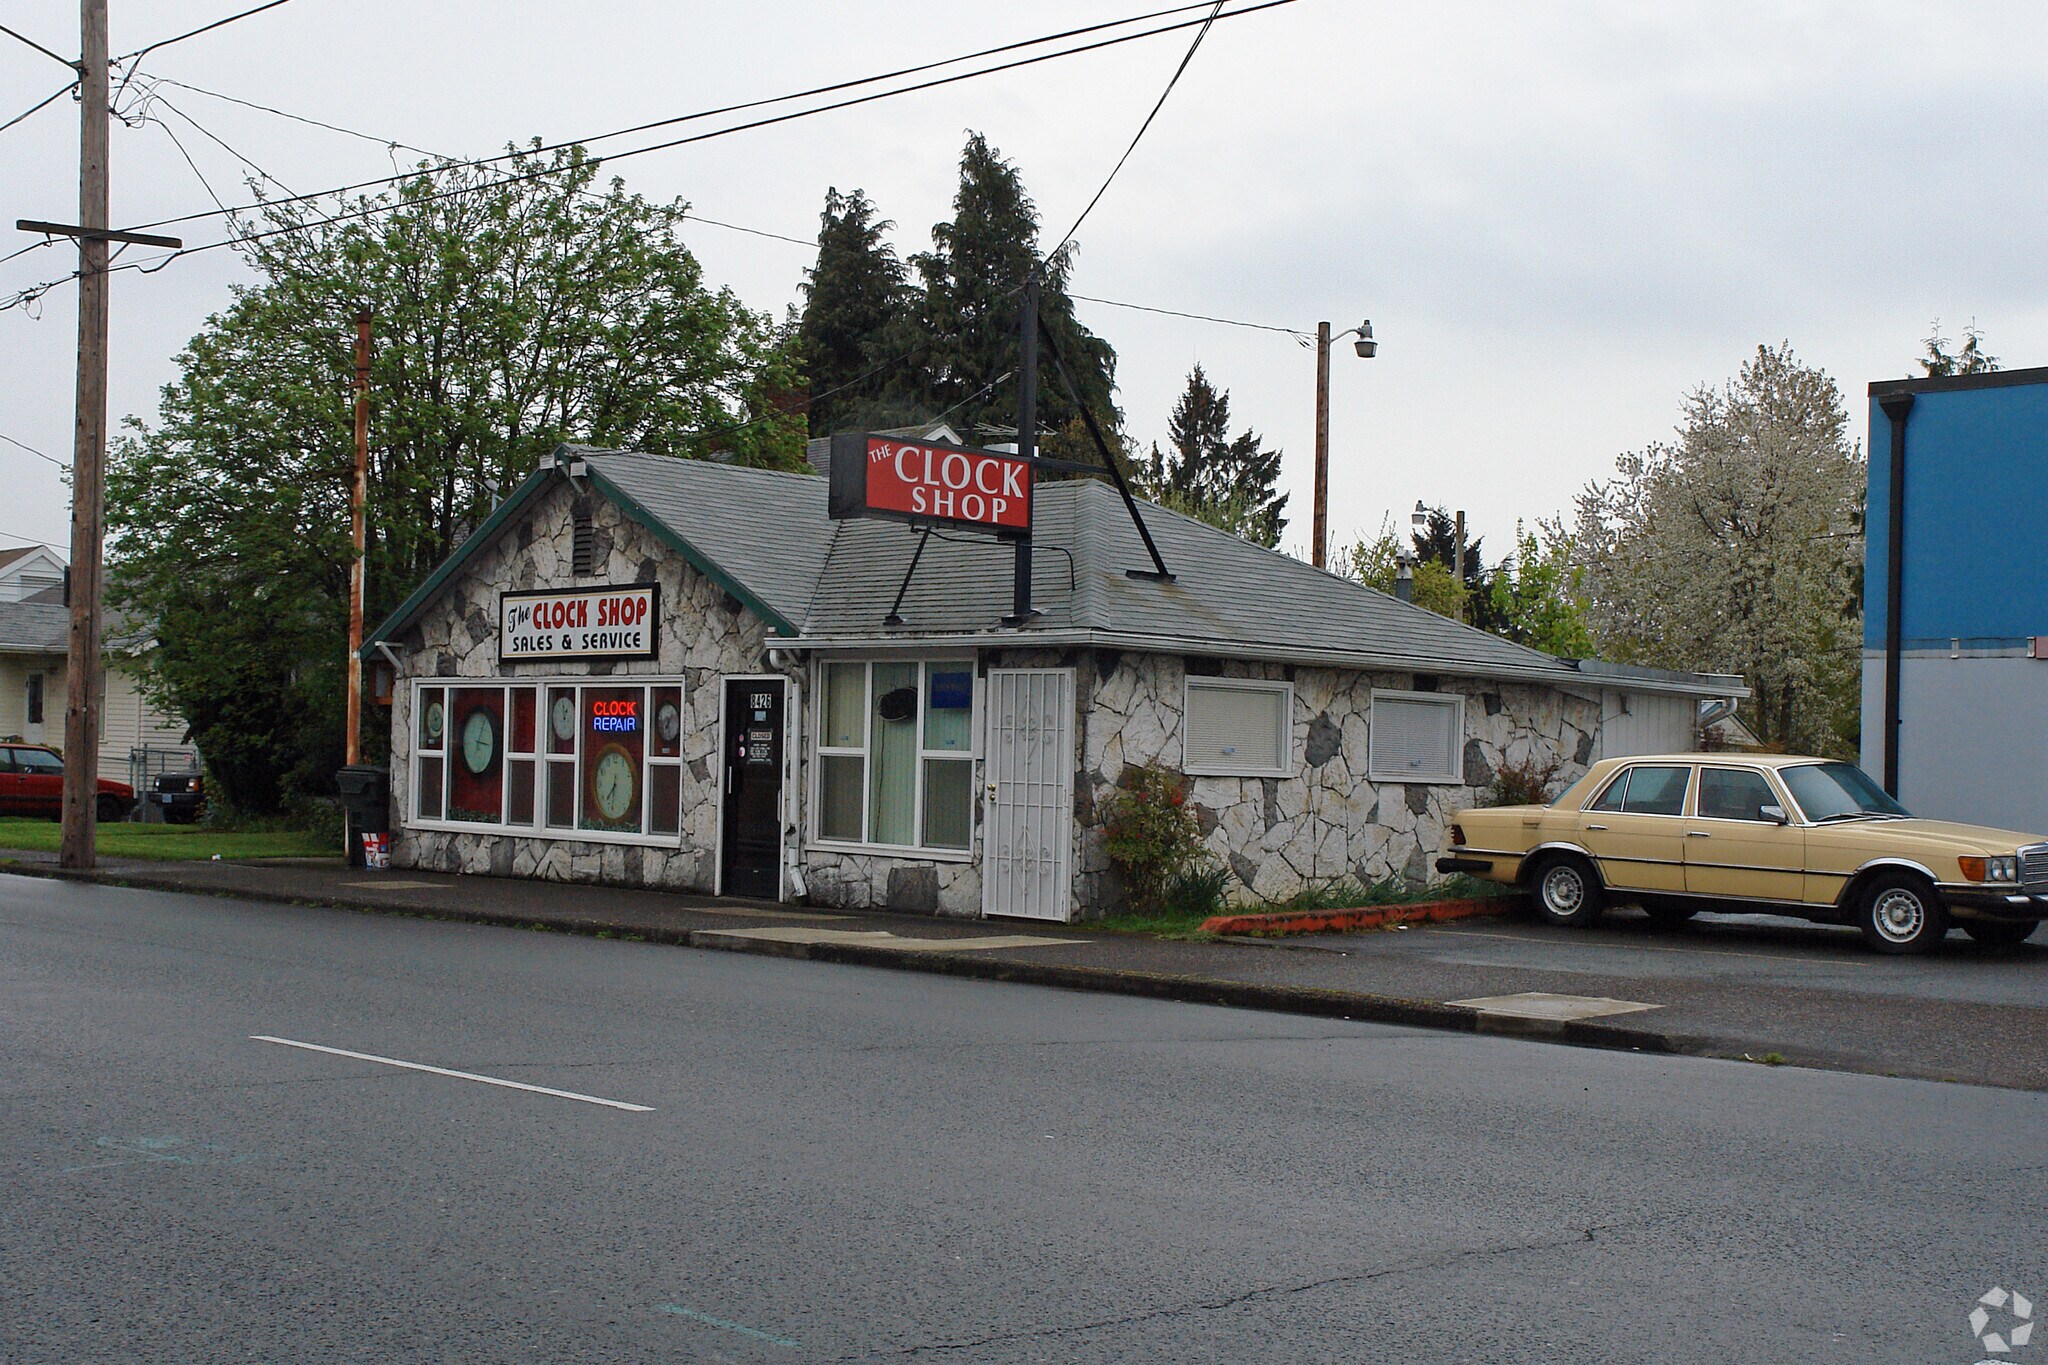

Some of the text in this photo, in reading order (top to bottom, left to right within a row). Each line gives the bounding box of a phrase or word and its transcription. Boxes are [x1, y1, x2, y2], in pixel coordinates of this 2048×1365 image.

[869, 444, 892, 463] THE
[895, 446, 1024, 498] CLOCK
[912, 486, 1007, 523] SHOP
[508, 596, 647, 633] The CLOCK SHOP
[513, 631, 641, 652] SALES & SERVICE
[593, 701, 637, 716] CLOCK
[751, 694, 771, 708] 8426
[593, 717, 636, 731] REPAIR
